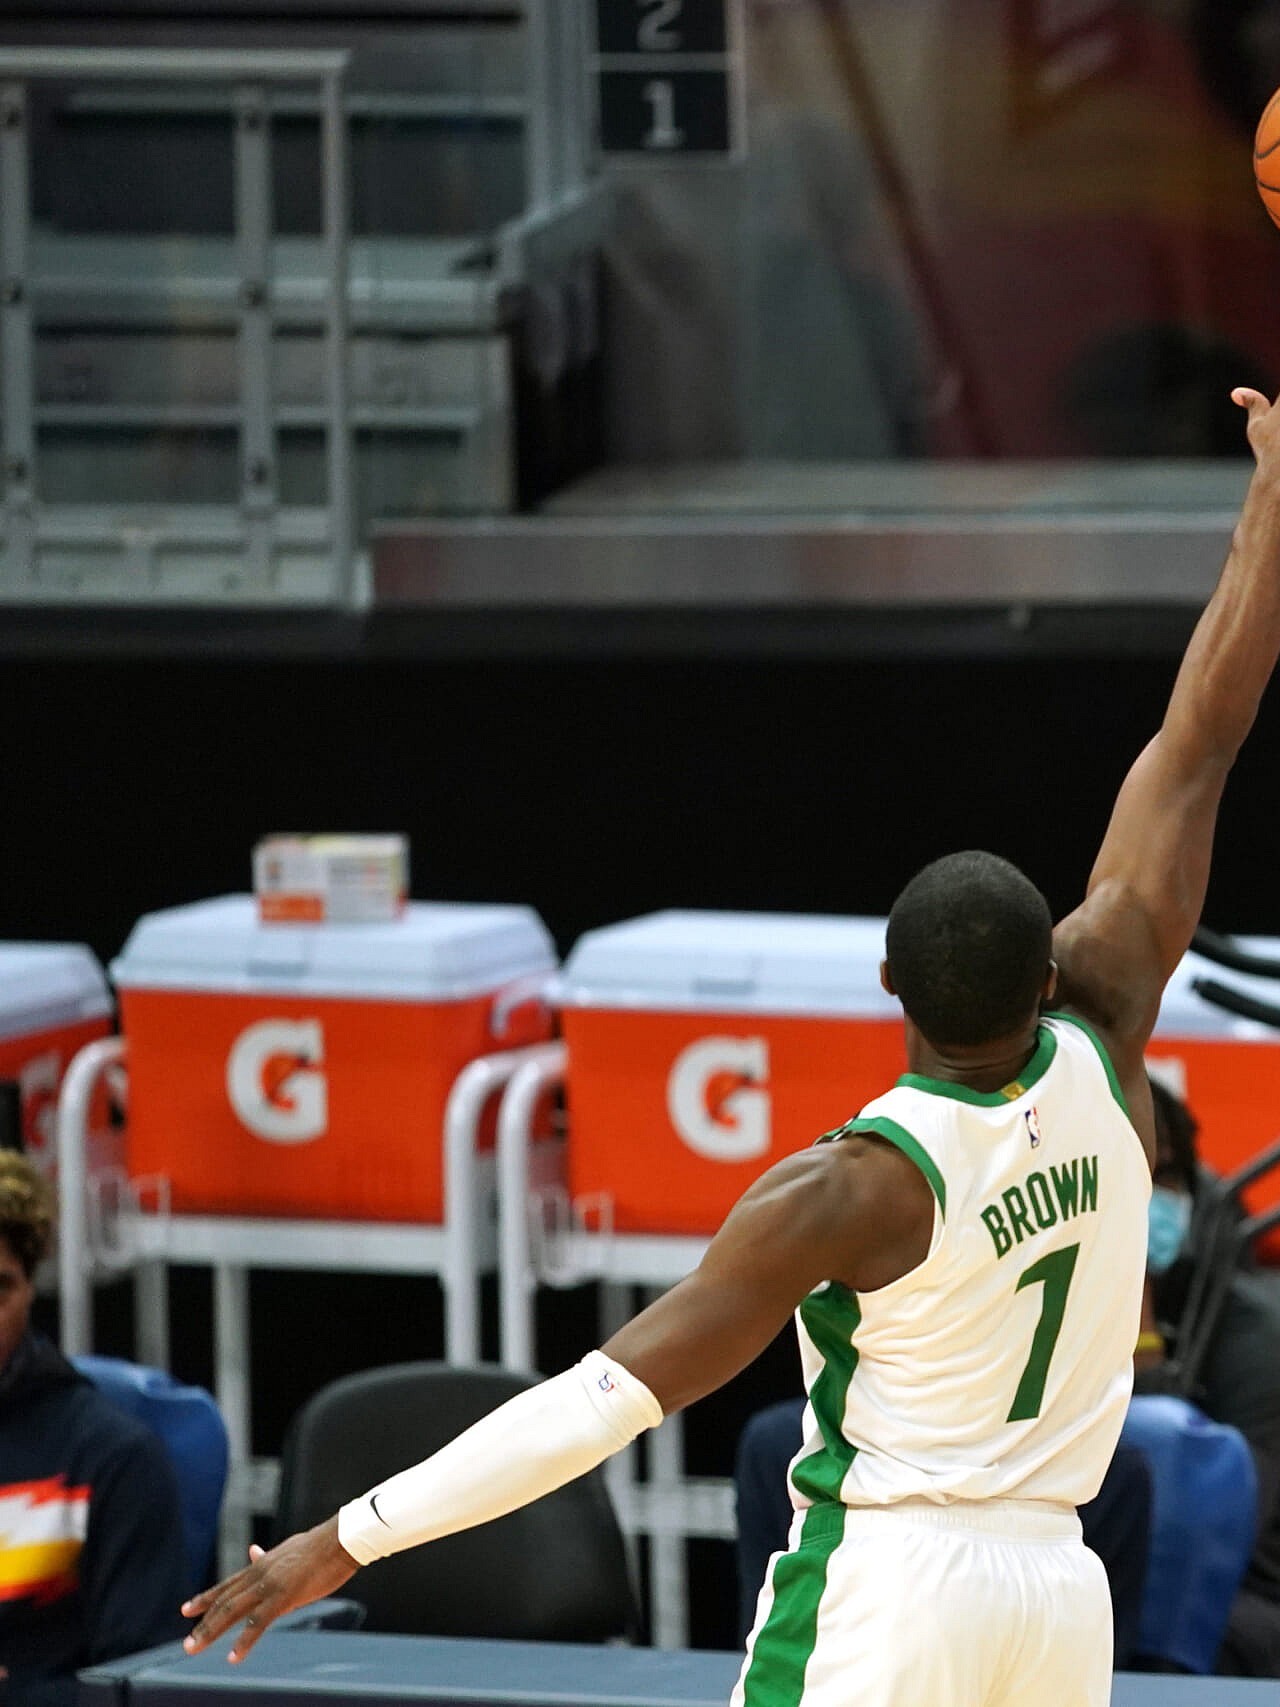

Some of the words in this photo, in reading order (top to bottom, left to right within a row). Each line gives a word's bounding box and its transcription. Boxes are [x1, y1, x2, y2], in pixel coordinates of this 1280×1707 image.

[636, 0, 682, 49] 2
[641, 79, 688, 149] 1
[225, 1018, 328, 1146] G
[666, 1035, 772, 1162] G
[980, 1155, 1098, 1260] BROWN
[1006, 1242, 1081, 1423] 7
